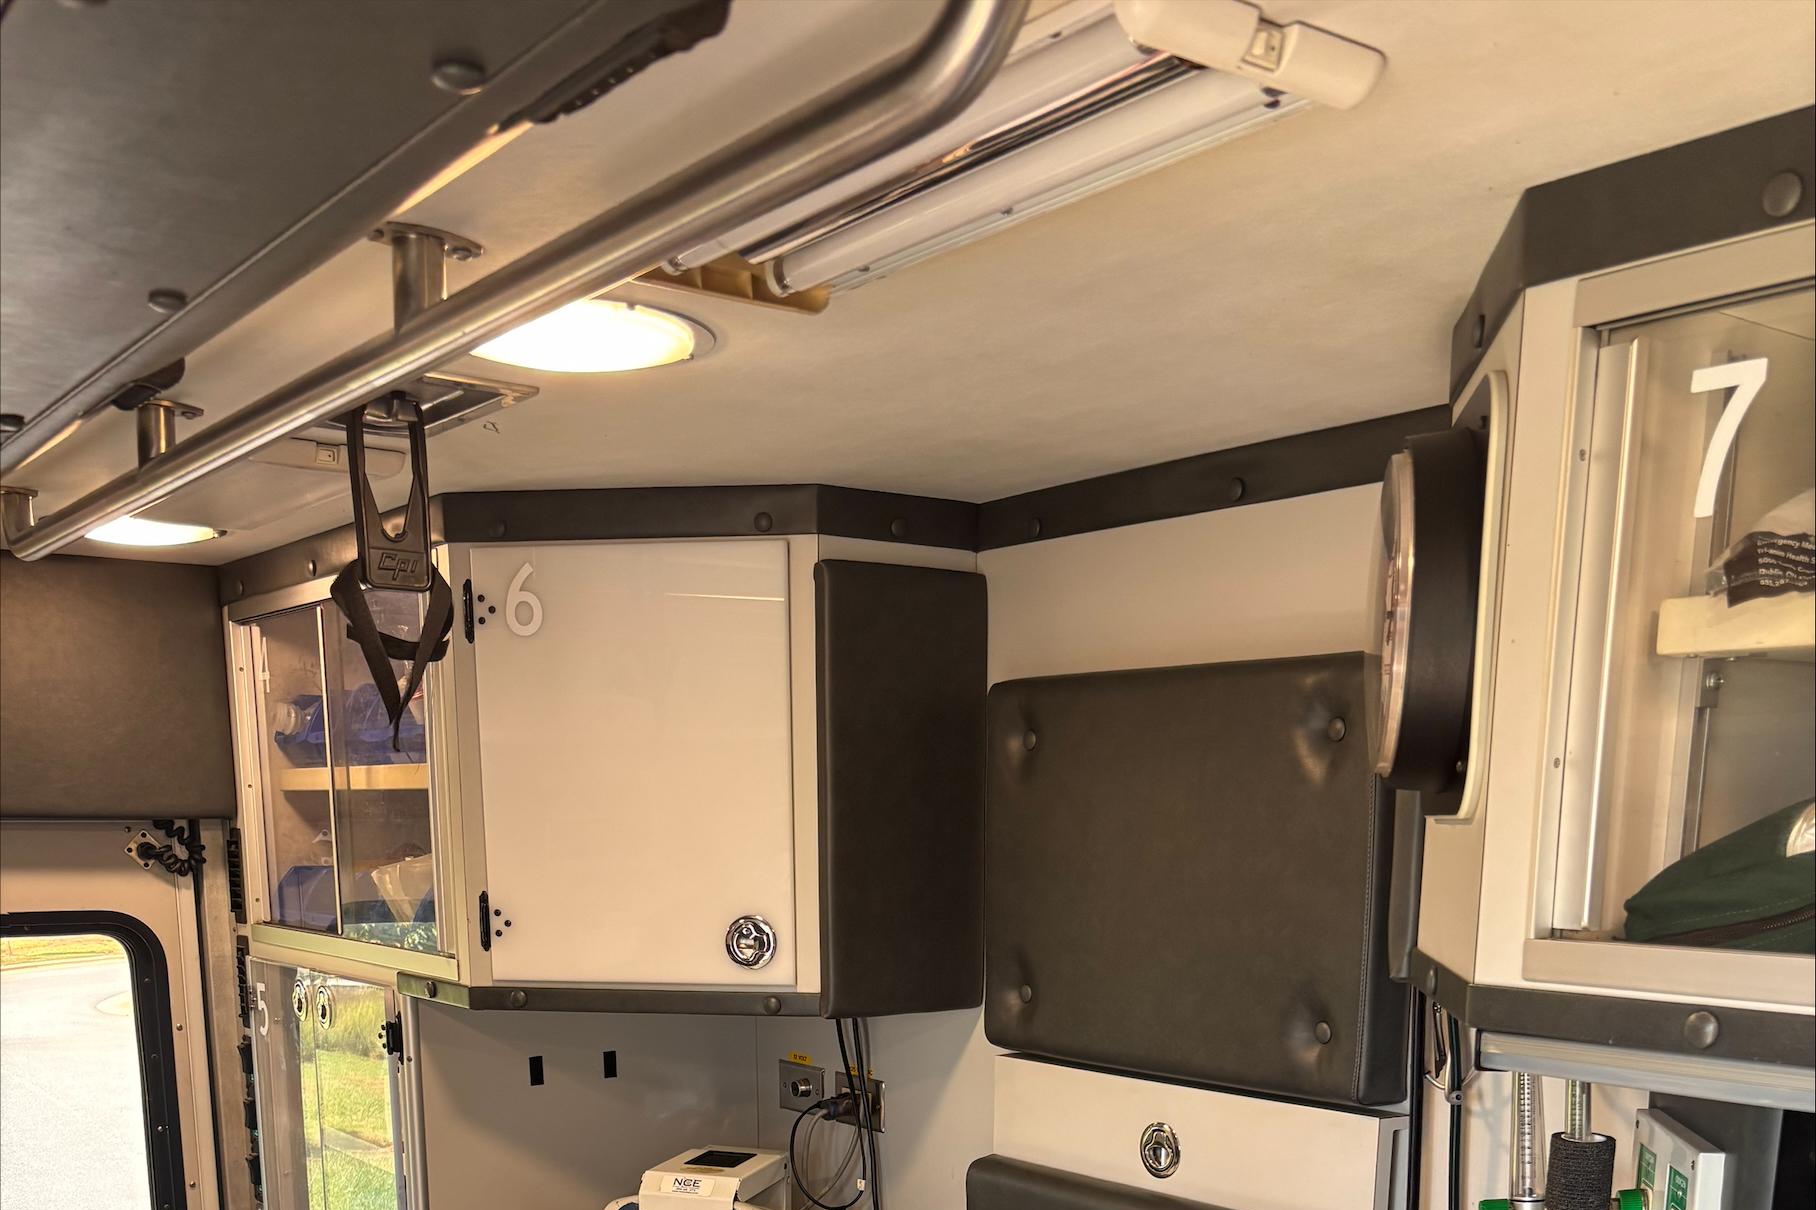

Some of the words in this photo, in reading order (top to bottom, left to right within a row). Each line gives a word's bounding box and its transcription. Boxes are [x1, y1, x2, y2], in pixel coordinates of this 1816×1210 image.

[1690, 357, 1768, 518] 7
[1786, 552, 1810, 563] Health
[505, 562, 543, 637] 6
[256, 982, 269, 1036] 5
[673, 1177, 702, 1188] NCE
